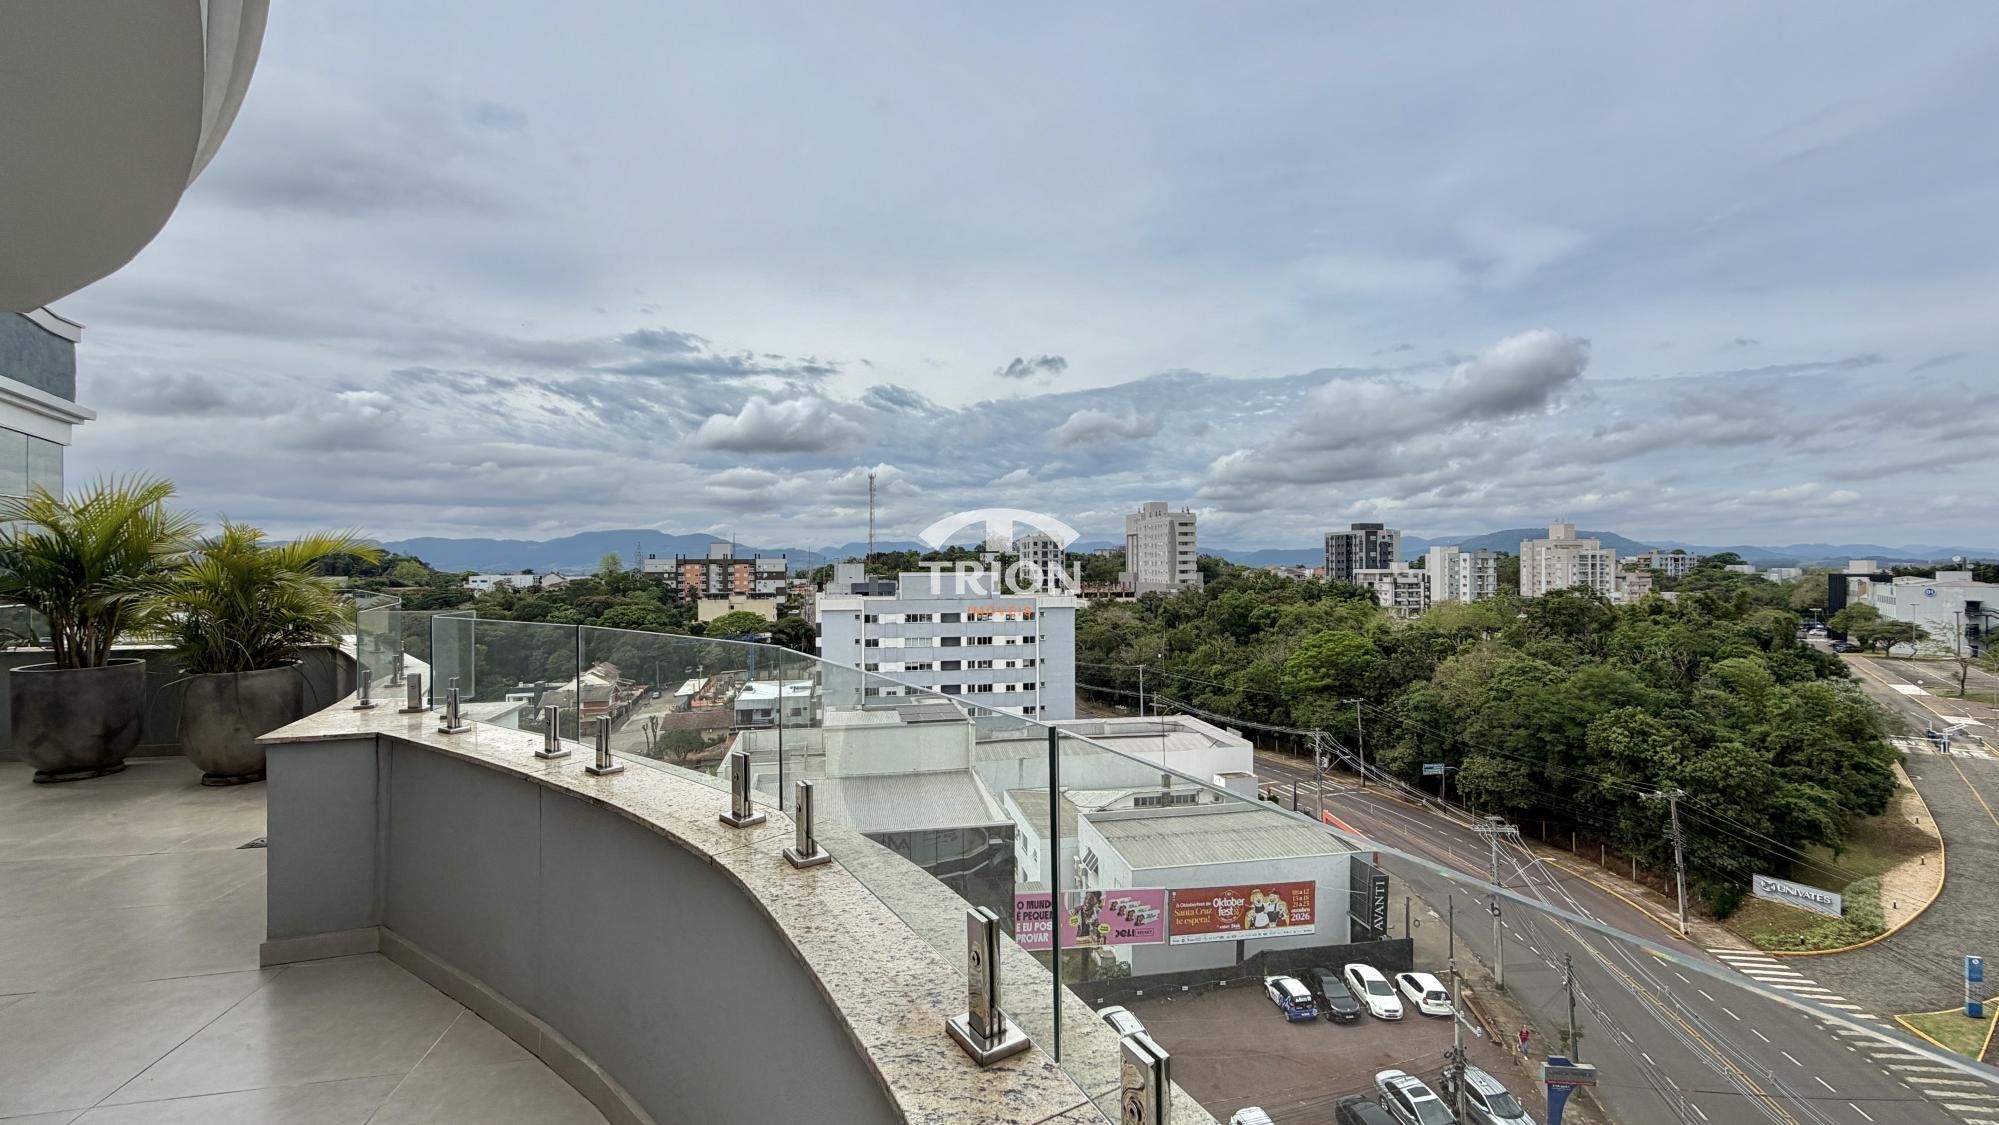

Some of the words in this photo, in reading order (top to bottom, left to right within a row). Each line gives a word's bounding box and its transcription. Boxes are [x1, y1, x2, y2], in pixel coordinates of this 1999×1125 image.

[1777, 884, 1831, 904] UNIVATES
[1016, 901, 1024, 910] O
[1026, 900, 1052, 910] MUND
[1213, 896, 1245, 908] Oktober
[1374, 881, 1385, 931] AVANTI
[1022, 911, 1052, 921] PEQUE
[1174, 908, 1195, 917] Santa
[1195, 908, 1212, 916] Cruz
[1218, 906, 1234, 917] fest
[1291, 912, 1311, 921] 2026
[1016, 922, 1021, 933] E
[1023, 922, 1033, 932] EU
[1034, 921, 1052, 932] POS
[1016, 932, 1049, 943] PROVAR
